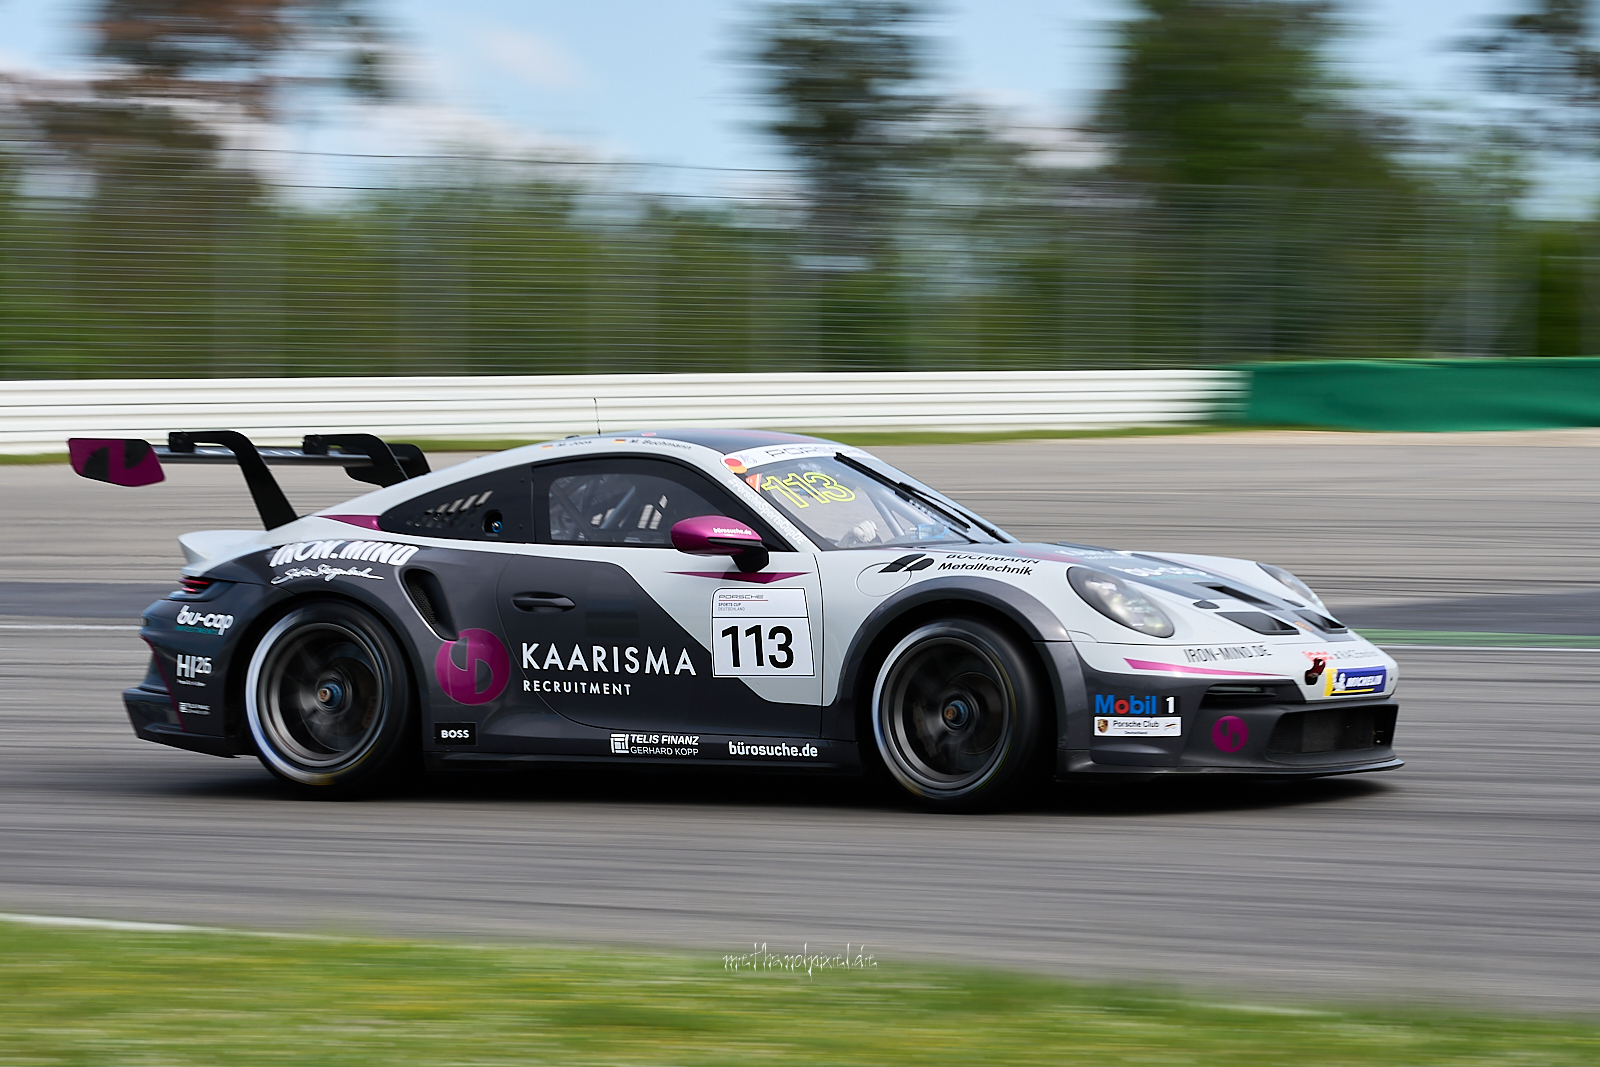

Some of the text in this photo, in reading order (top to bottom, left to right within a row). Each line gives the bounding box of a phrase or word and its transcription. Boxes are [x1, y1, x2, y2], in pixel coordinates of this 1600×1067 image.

[761, 472, 856, 509] 113
[937, 562, 1033, 576] Metalltechnik
[176, 604, 235, 636] bu-cap
[721, 625, 795, 669] 113
[1183, 645, 1273, 664] IRON-MIND.DE
[521, 642, 697, 676] KAARISMA
[522, 679, 632, 696] RECRUITMENT
[1345, 674, 1384, 688] MICHELIN
[1094, 694, 1175, 715] Mobil 1
[1113, 719, 1160, 728] Porsche Club
[440, 729, 470, 739] BOSS
[630, 734, 700, 746] TELIS FINANZ
[630, 746, 699, 757] GERHARD KOPP
[728, 741, 819, 758] bürosuche.de
